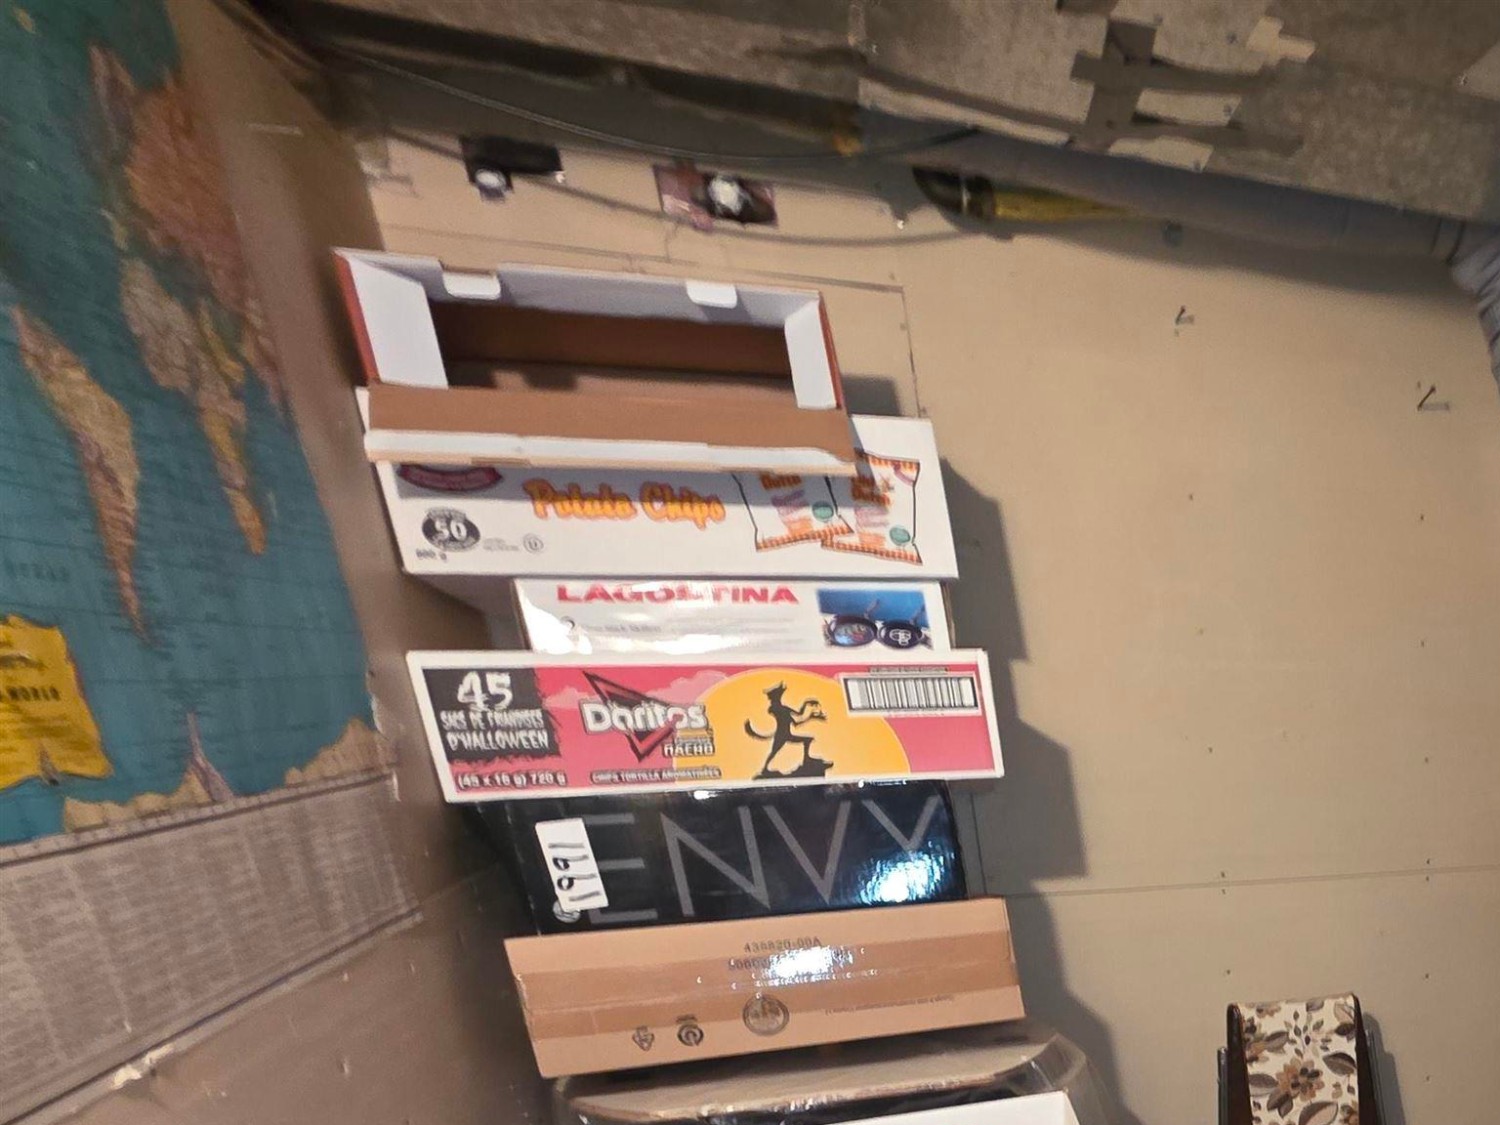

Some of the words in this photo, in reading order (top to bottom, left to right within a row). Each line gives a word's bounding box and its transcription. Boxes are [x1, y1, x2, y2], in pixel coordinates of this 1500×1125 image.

[522, 477, 638, 520] Potato
[639, 480, 727, 531] Chips
[456, 671, 514, 711] 45
[582, 700, 709, 734] Doritos
[446, 729, 550, 753] D'HALLOWEEN
[620, 769, 661, 783] TORTILLA
